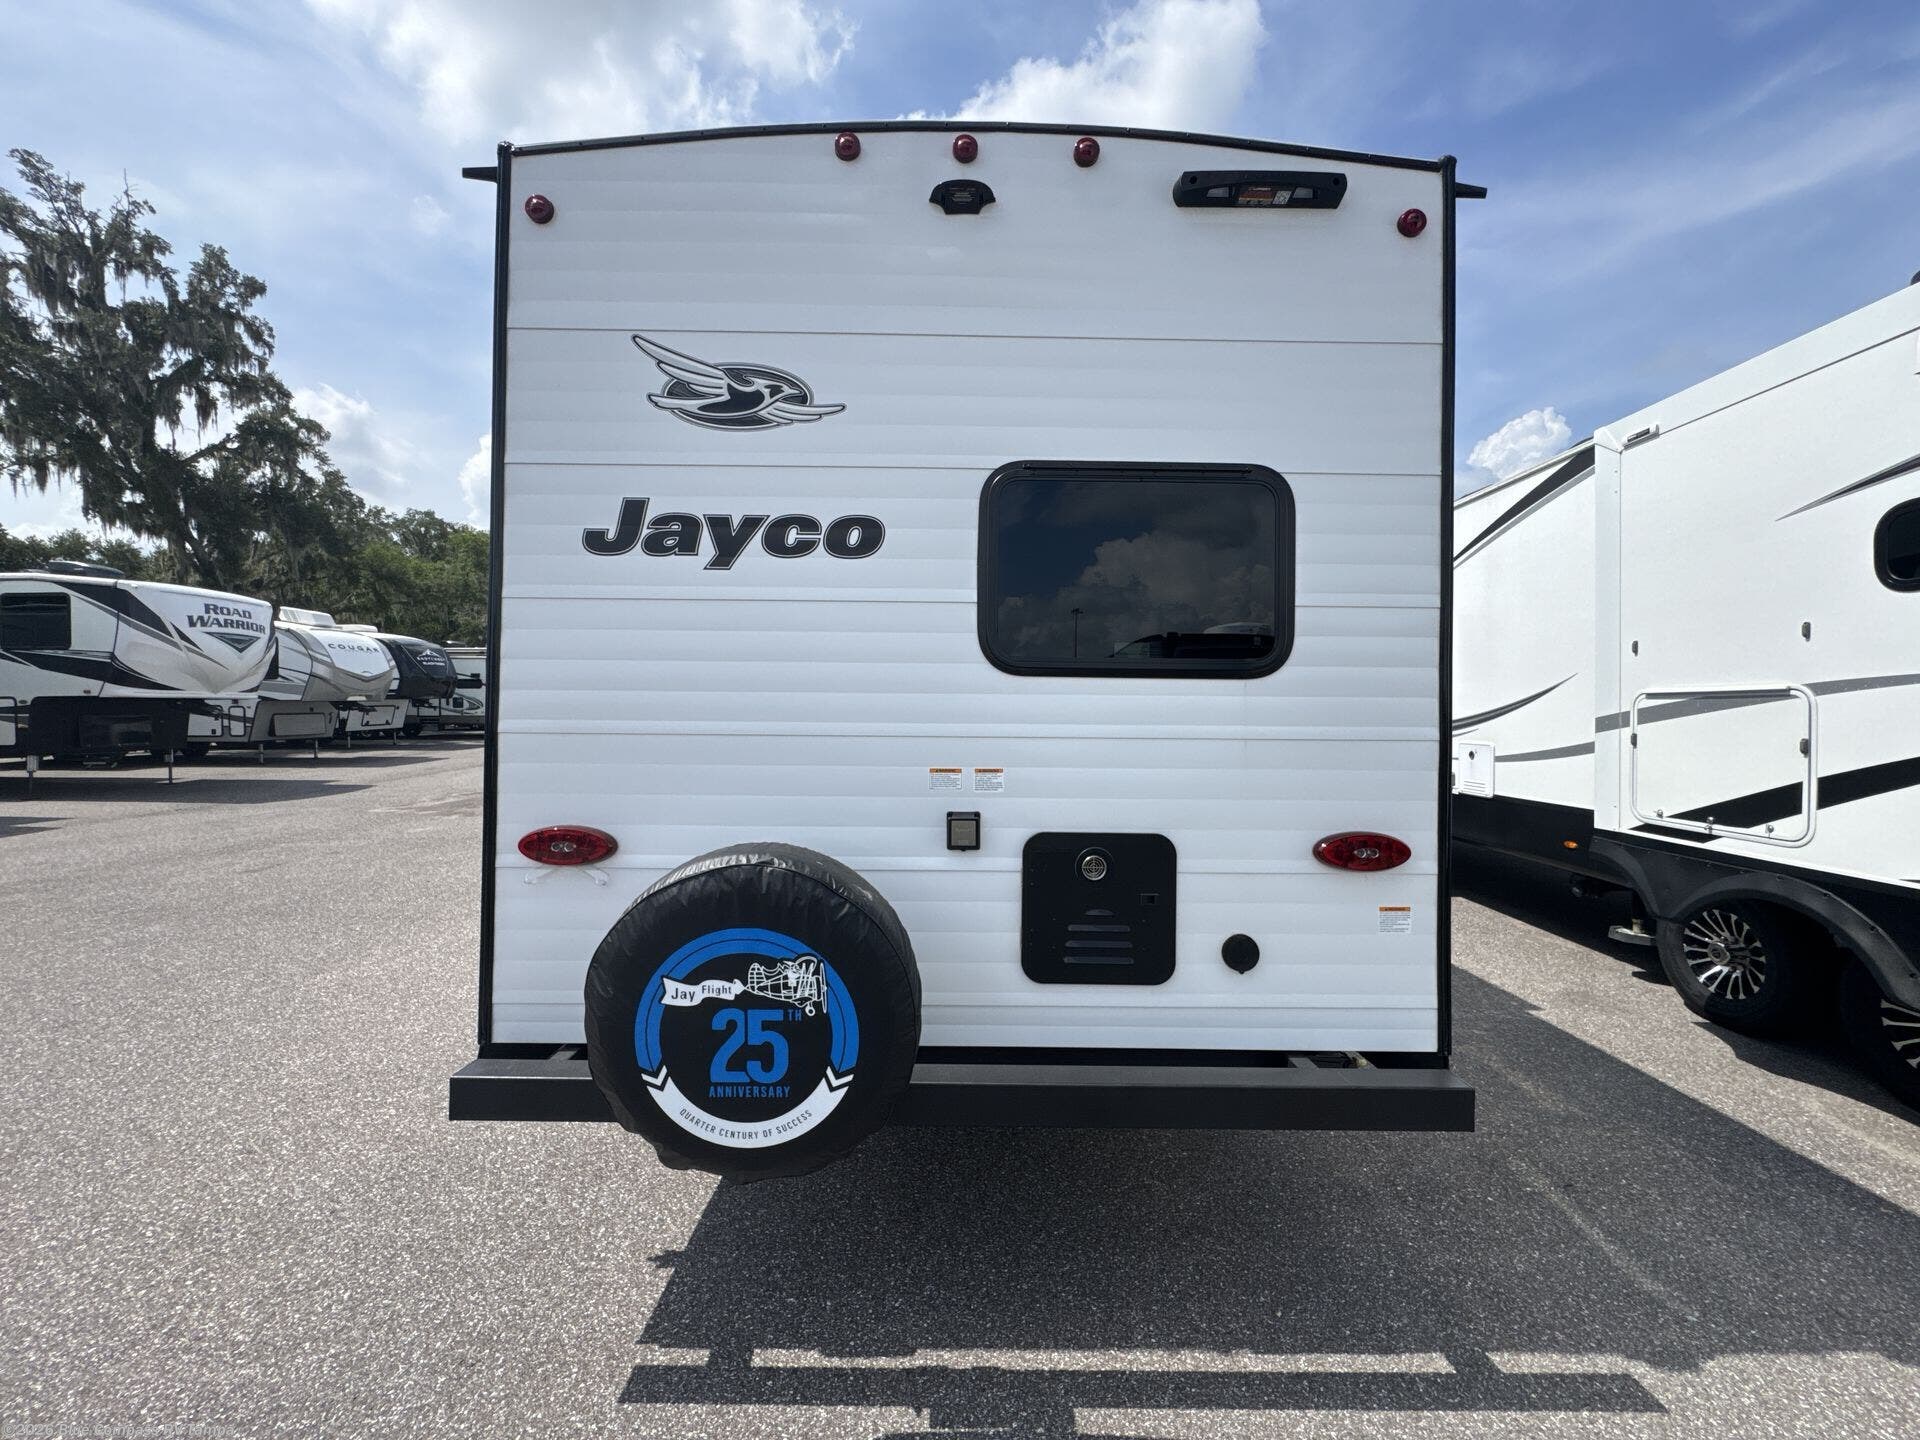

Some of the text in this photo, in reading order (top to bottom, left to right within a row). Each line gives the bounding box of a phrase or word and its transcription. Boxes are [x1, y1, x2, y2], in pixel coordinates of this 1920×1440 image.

[581, 496, 886, 570] Jayco
[204, 603, 252, 619] ROAD
[186, 615, 266, 634] WARRIOR
[671, 984, 733, 1002] Jay Flight
[708, 1085, 791, 1098] ANNIVERSARY
[679, 1108, 813, 1140] QUARTER CENTURY OF SUCCESS
